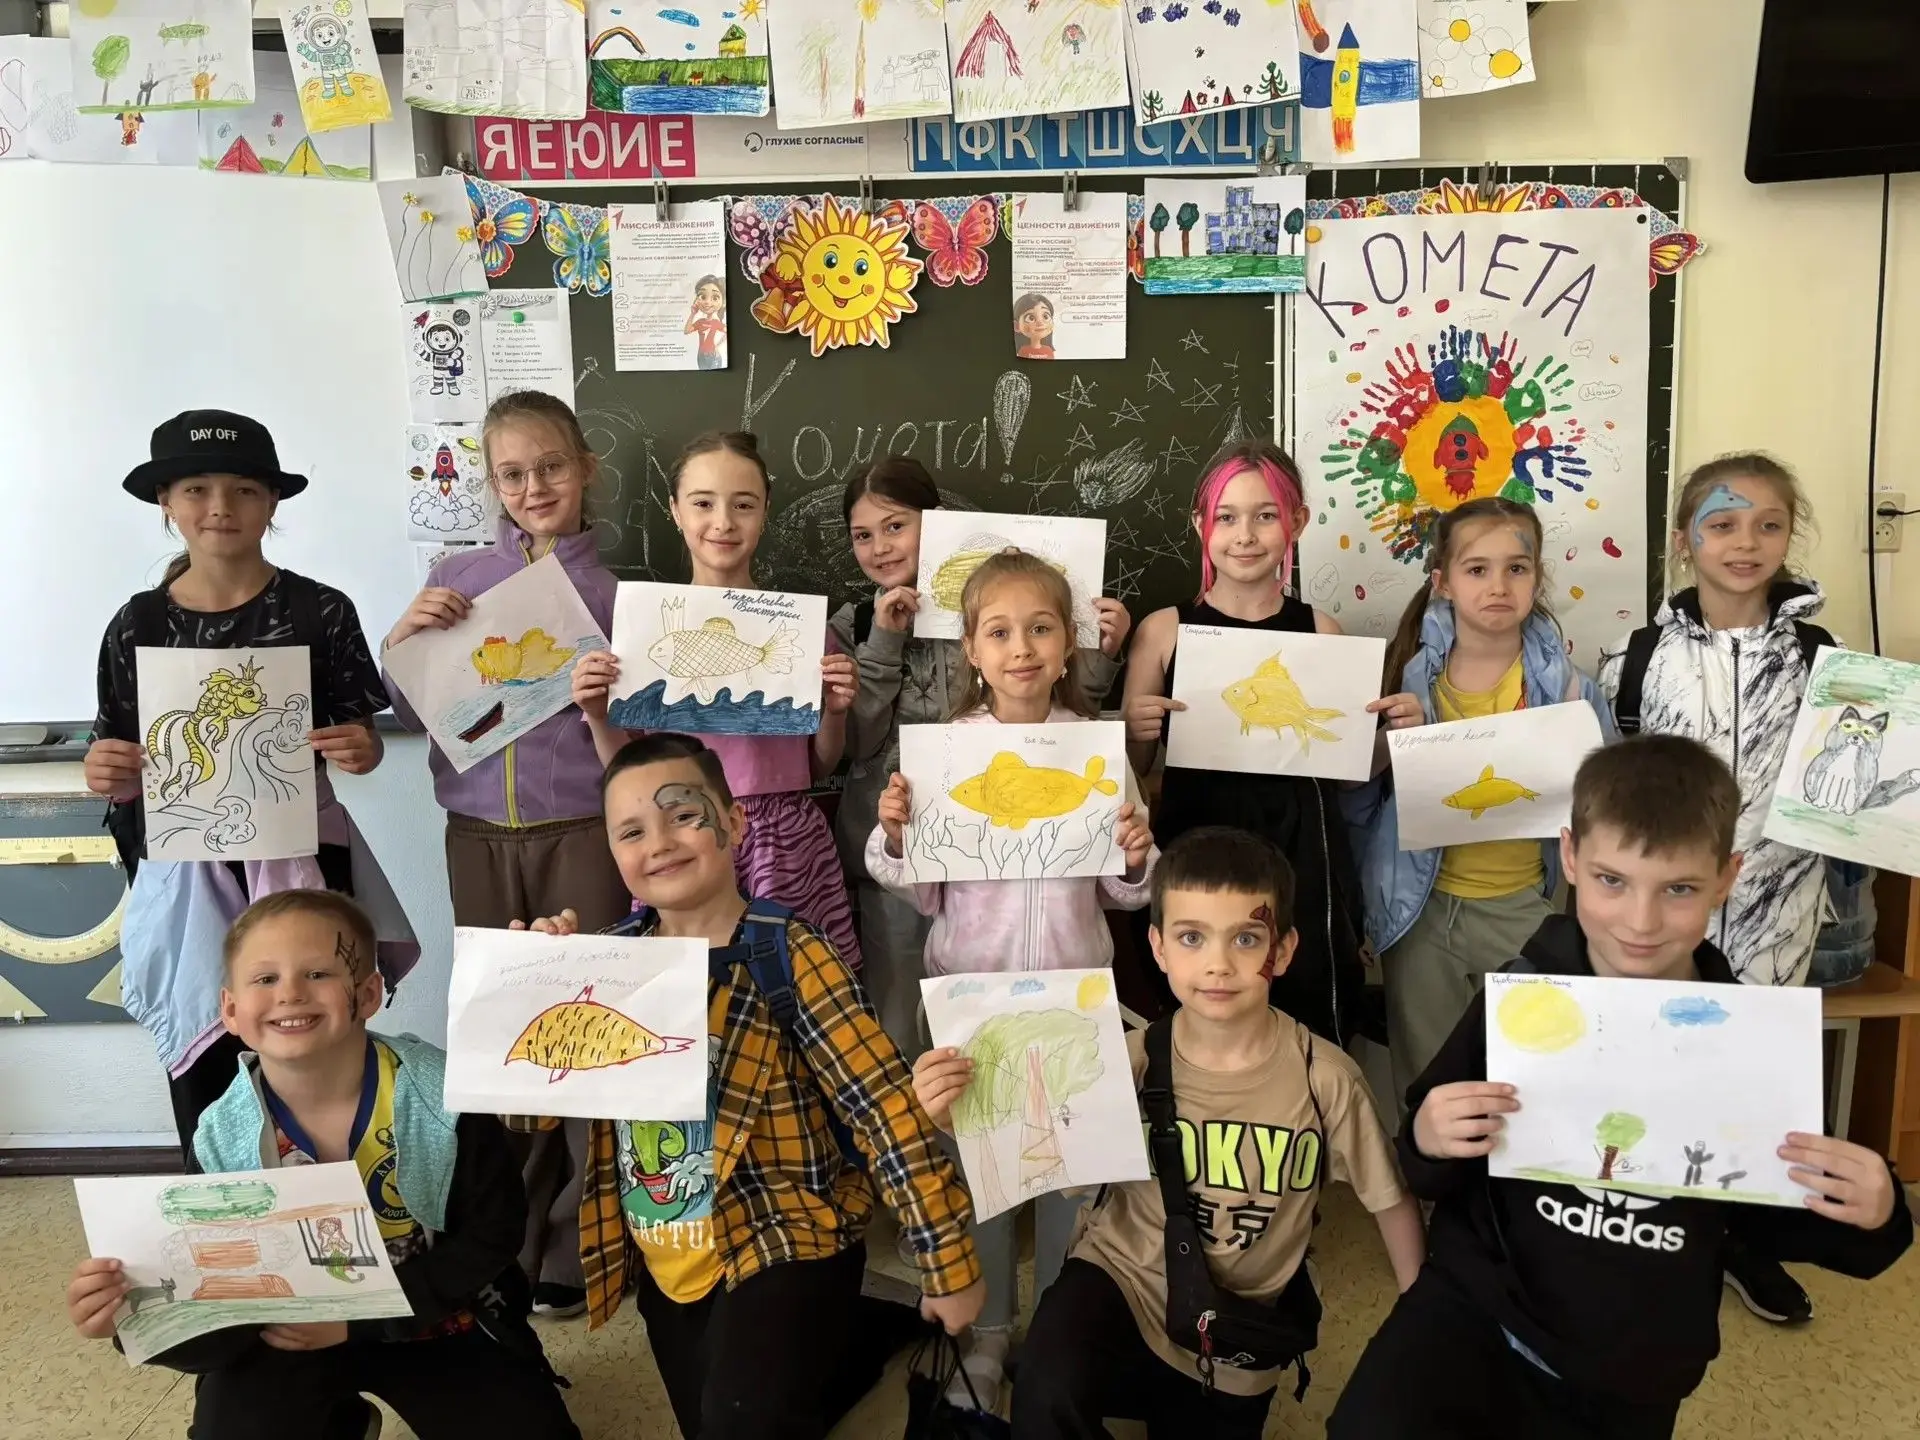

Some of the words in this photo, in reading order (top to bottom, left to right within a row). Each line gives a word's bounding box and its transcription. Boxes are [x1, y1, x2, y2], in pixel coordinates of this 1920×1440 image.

[765, 137, 803, 146] ГЛУХИЕ
[804, 135, 865, 146] СОГЛАСНЫЕ
[620, 221, 661, 231] МИССИЯ
[662, 220, 715, 231] ДВИЖЕНИЯ
[1017, 222, 1067, 230] ЦЕННОСТИ
[1068, 222, 1121, 230] ДВИЖЕНИЯ
[1306, 229, 1596, 338] КОМЕТА
[614, 293, 630, 309] 2
[615, 317, 630, 333] 3
[190, 428, 213, 442] DAY
[215, 428, 238, 441] OFF
[1535, 1194, 1687, 1252] adidas
